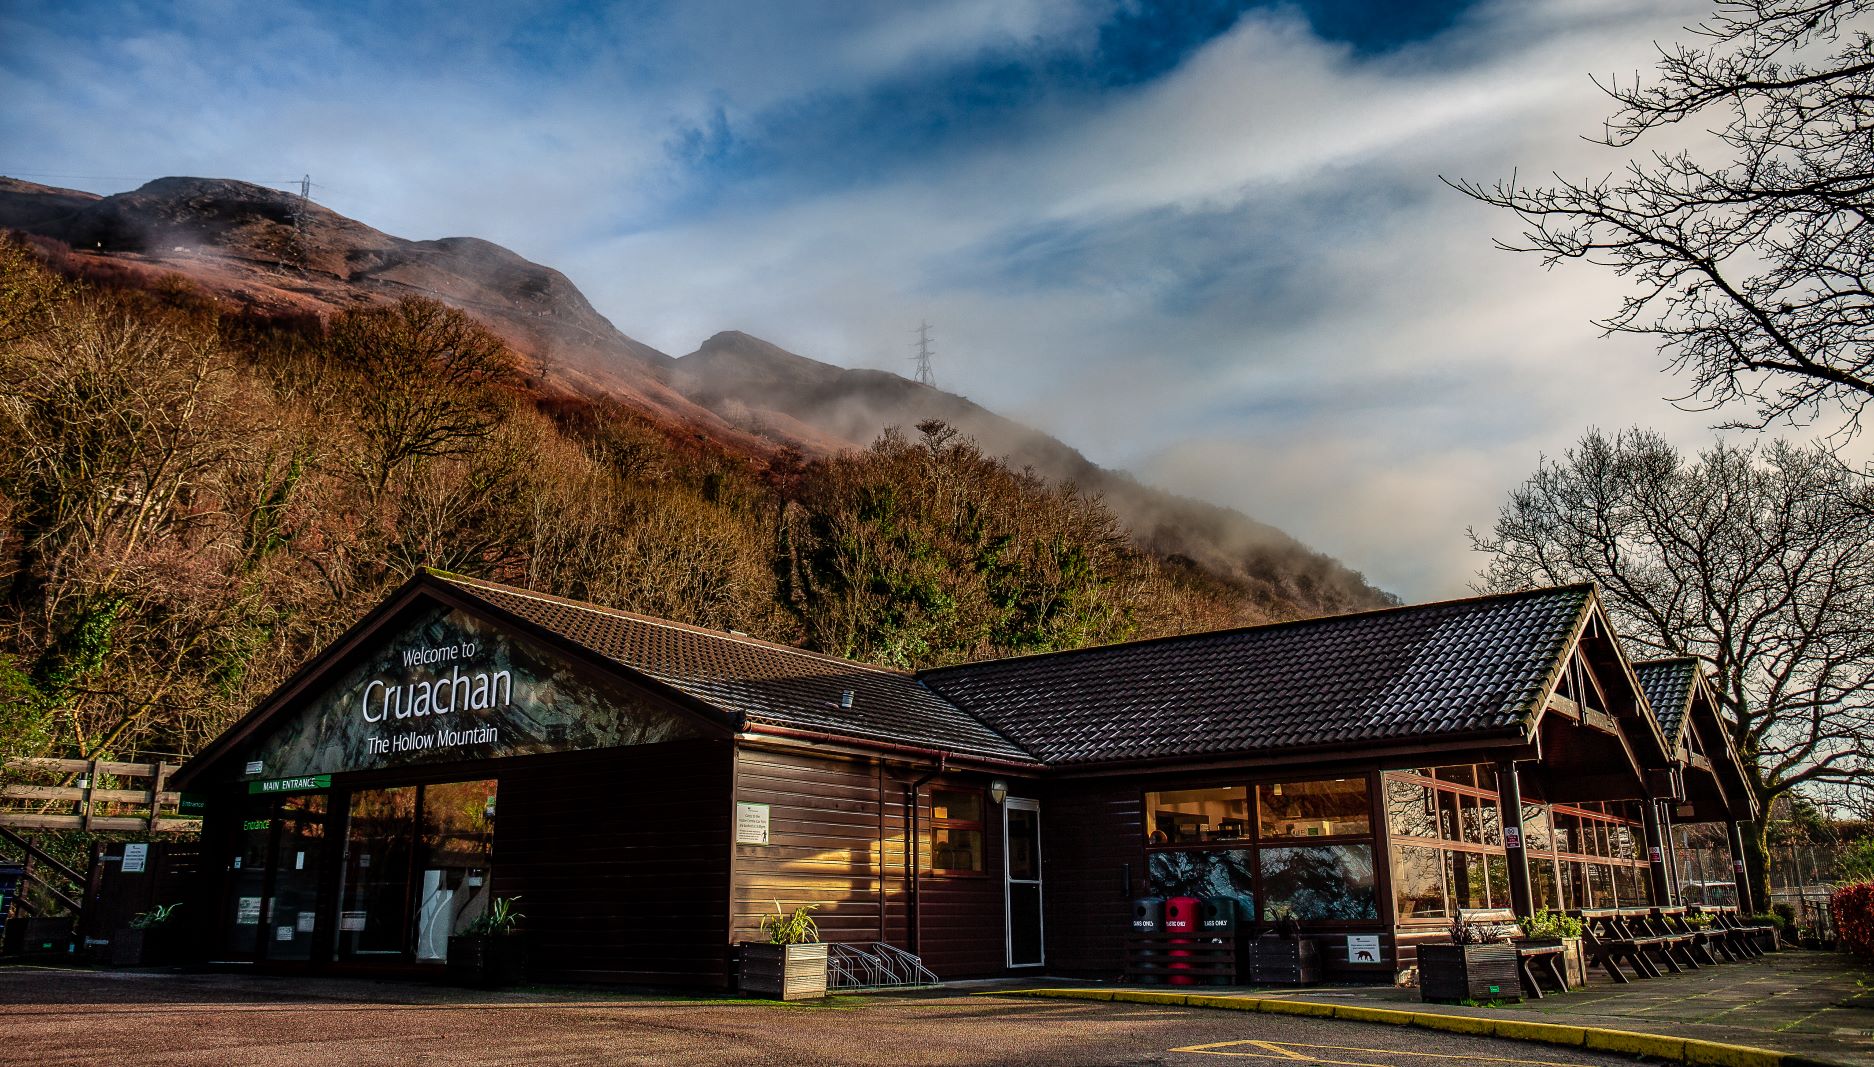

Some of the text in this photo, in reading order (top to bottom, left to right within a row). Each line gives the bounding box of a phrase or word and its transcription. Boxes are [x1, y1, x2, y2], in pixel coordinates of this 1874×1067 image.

[403, 642, 475, 667] Welcome to
[362, 665, 511, 723] Cruachan
[368, 724, 498, 755] The Hollow Mountain
[263, 778, 315, 791] MAIN ENTRANCE
[243, 819, 270, 830] Entrance
